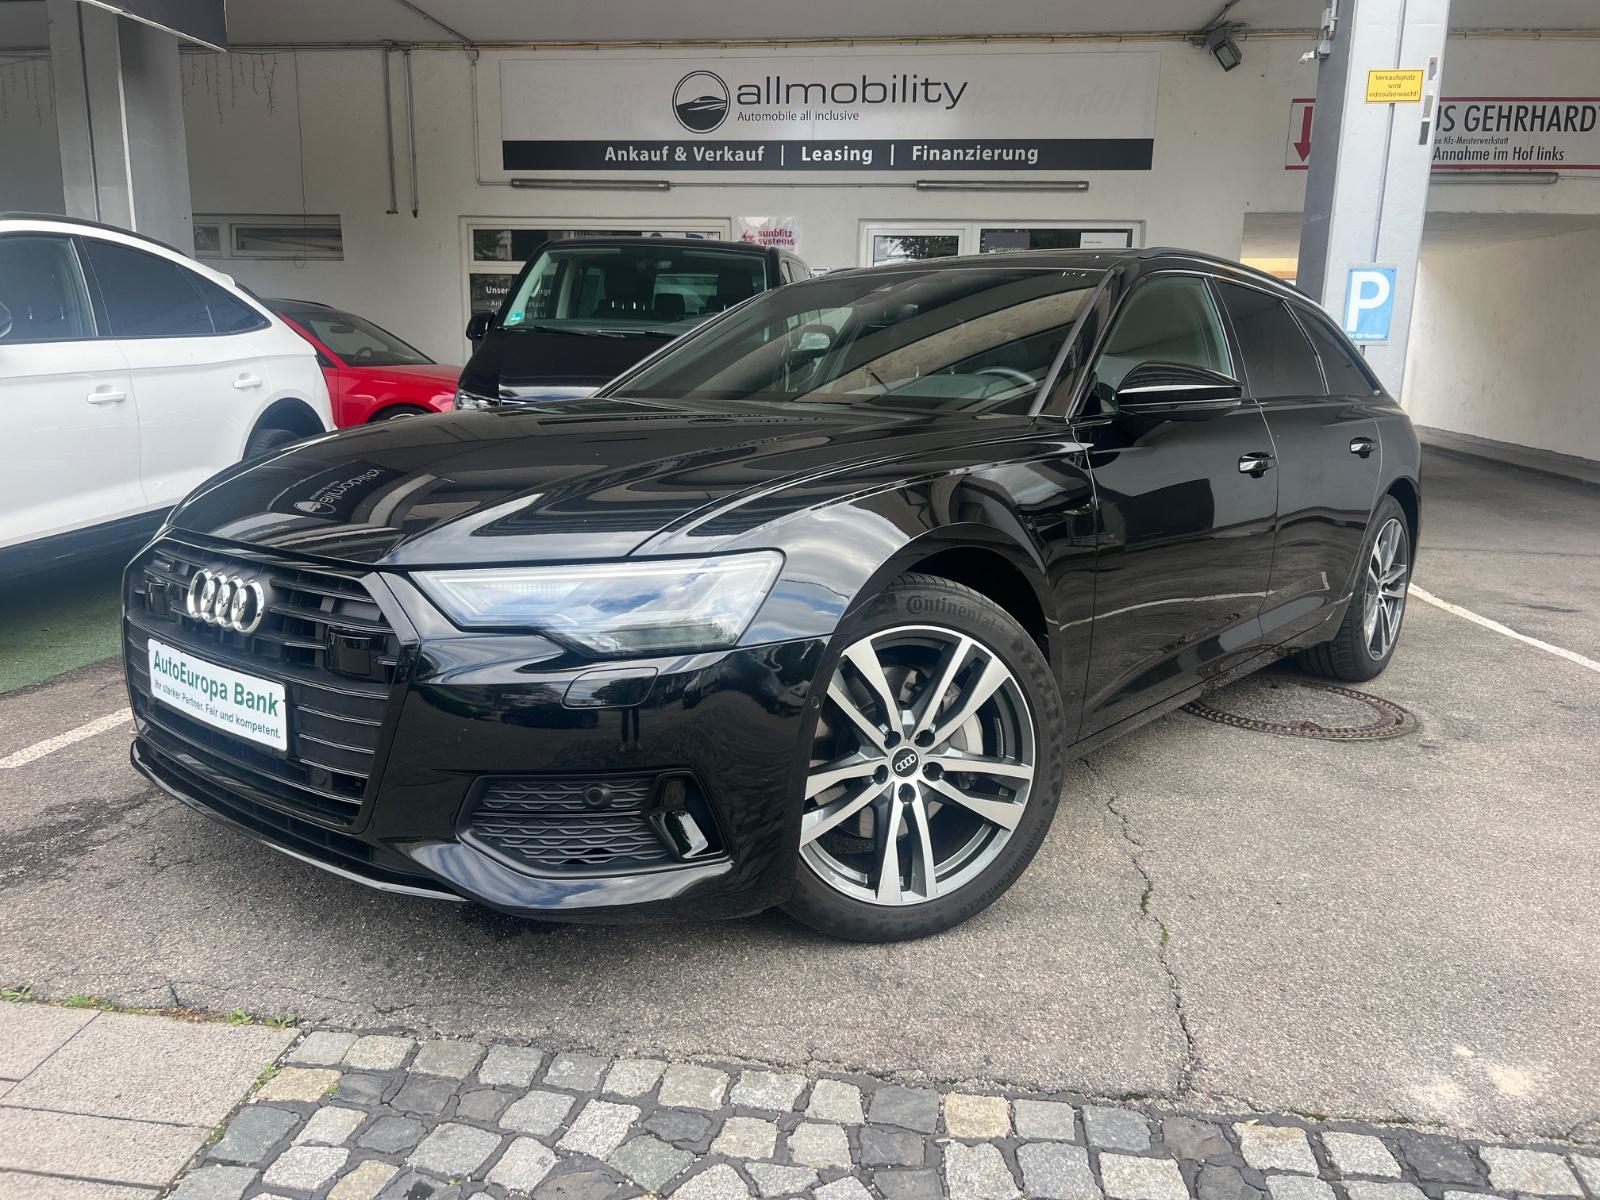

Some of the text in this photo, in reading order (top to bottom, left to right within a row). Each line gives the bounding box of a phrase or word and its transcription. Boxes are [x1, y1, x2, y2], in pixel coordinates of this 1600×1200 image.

[736, 74, 968, 110] allmobility
[737, 110, 860, 122] Automobile all inclusive
[1464, 104, 1600, 132] GEHRHARD
[1443, 136, 1509, 145] Kfz-Meisterwerkstatt
[604, 144, 1039, 165] Ankauf & Verkauf Leasing Finanzierung
[1432, 145, 1564, 161] Annahme im Hof links
[757, 228, 793, 238] sunblitz
[758, 237, 796, 246] systems
[1346, 271, 1391, 332] P
[906, 595, 996, 632] Continental
[153, 650, 279, 717] AutoEuropa Bank
[154, 679, 281, 739] Ihr starker Partner. Fair und kompetent.
